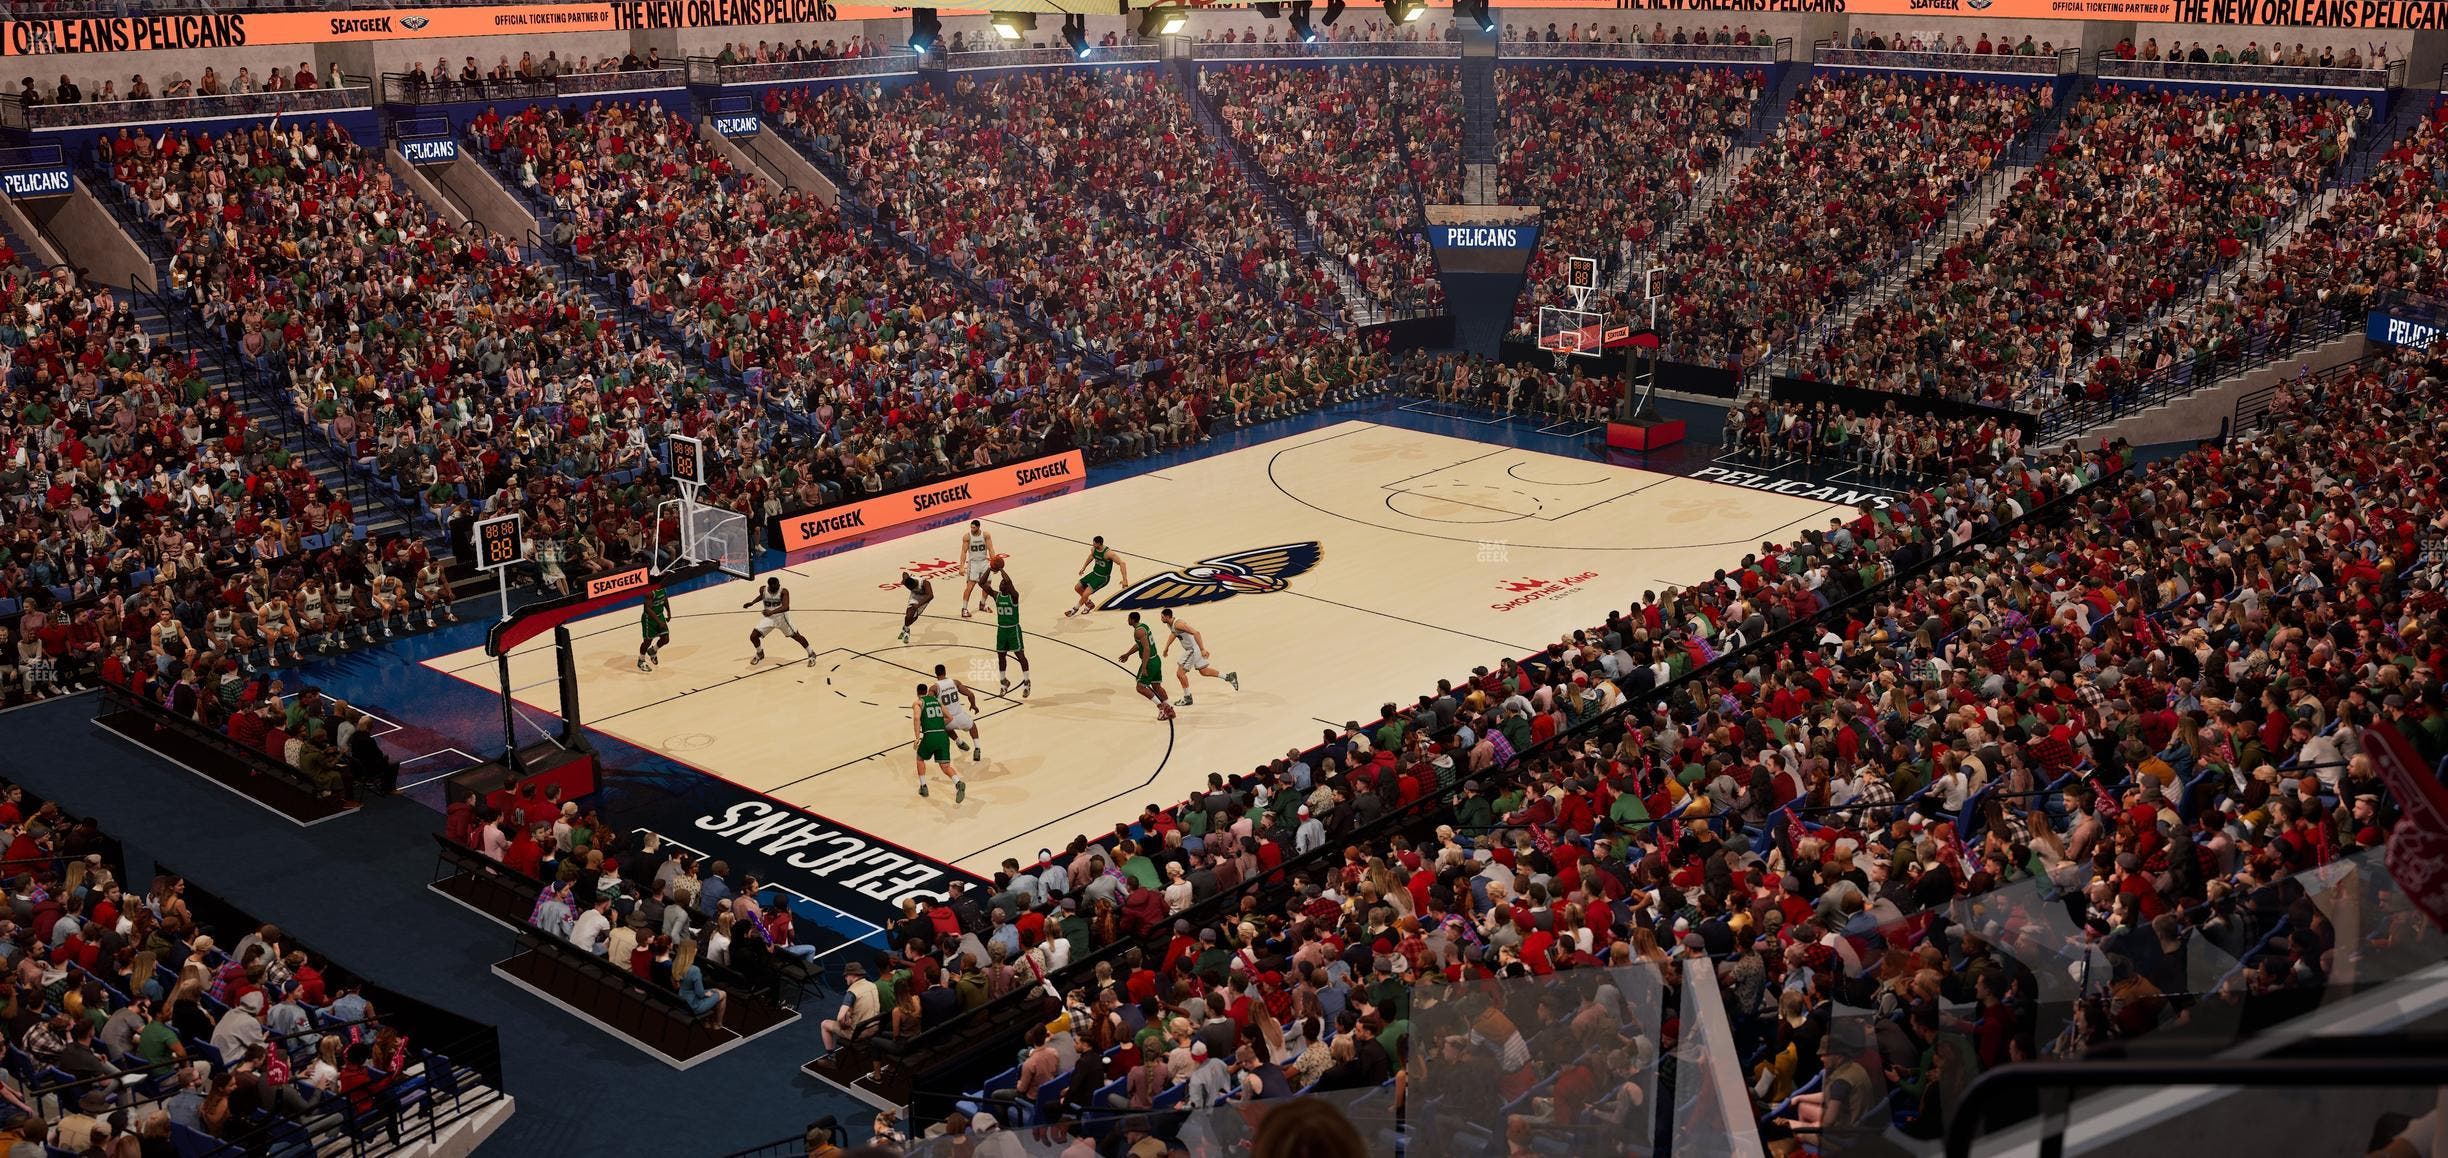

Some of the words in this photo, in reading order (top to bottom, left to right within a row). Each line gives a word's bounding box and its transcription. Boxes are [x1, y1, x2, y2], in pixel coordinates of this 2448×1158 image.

[495, 15, 527, 26] OFFICIAL
[529, 13, 566, 24] TICKETING
[568, 12, 599, 23] PARTNER
[600, 11, 609, 22] OF
[611, 3, 643, 30] THE
[648, 0, 683, 28] NEW
[688, 0, 761, 27] ORLEANS
[764, 0, 837, 24] PELICANS
[2052, 2, 2084, 11] OFFICIAL
[2086, 3, 2124, 12] TICKETING
[2125, 4, 2158, 13] PARTNER
[2160, 5, 2170, 14] OF
[2174, 0, 2209, 23] THE
[2211, 0, 2257, 24] NEW
[2261, 0, 2358, 27] ORLEANS
[13, 18, 129, 55] ORLEANS
[132, 15, 246, 50] PELICANS
[331, 16, 392, 35] SEATGEEK
[717, 117, 757, 134] PELICANS
[4, 171, 69, 193] PELICANS
[1447, 228, 1517, 247] PELICANS
[677, 456, 693, 476] 88
[1016, 459, 1070, 487] SEATGEEK
[913, 483, 972, 512] SEATGEEK
[1688, 466, 1894, 509] PELICANS
[800, 509, 864, 540] SEATGEEK
[491, 537, 512, 561] 88
[593, 572, 643, 594] SEATGEEK
[1491, 584, 1565, 612] SMOOTHIE
